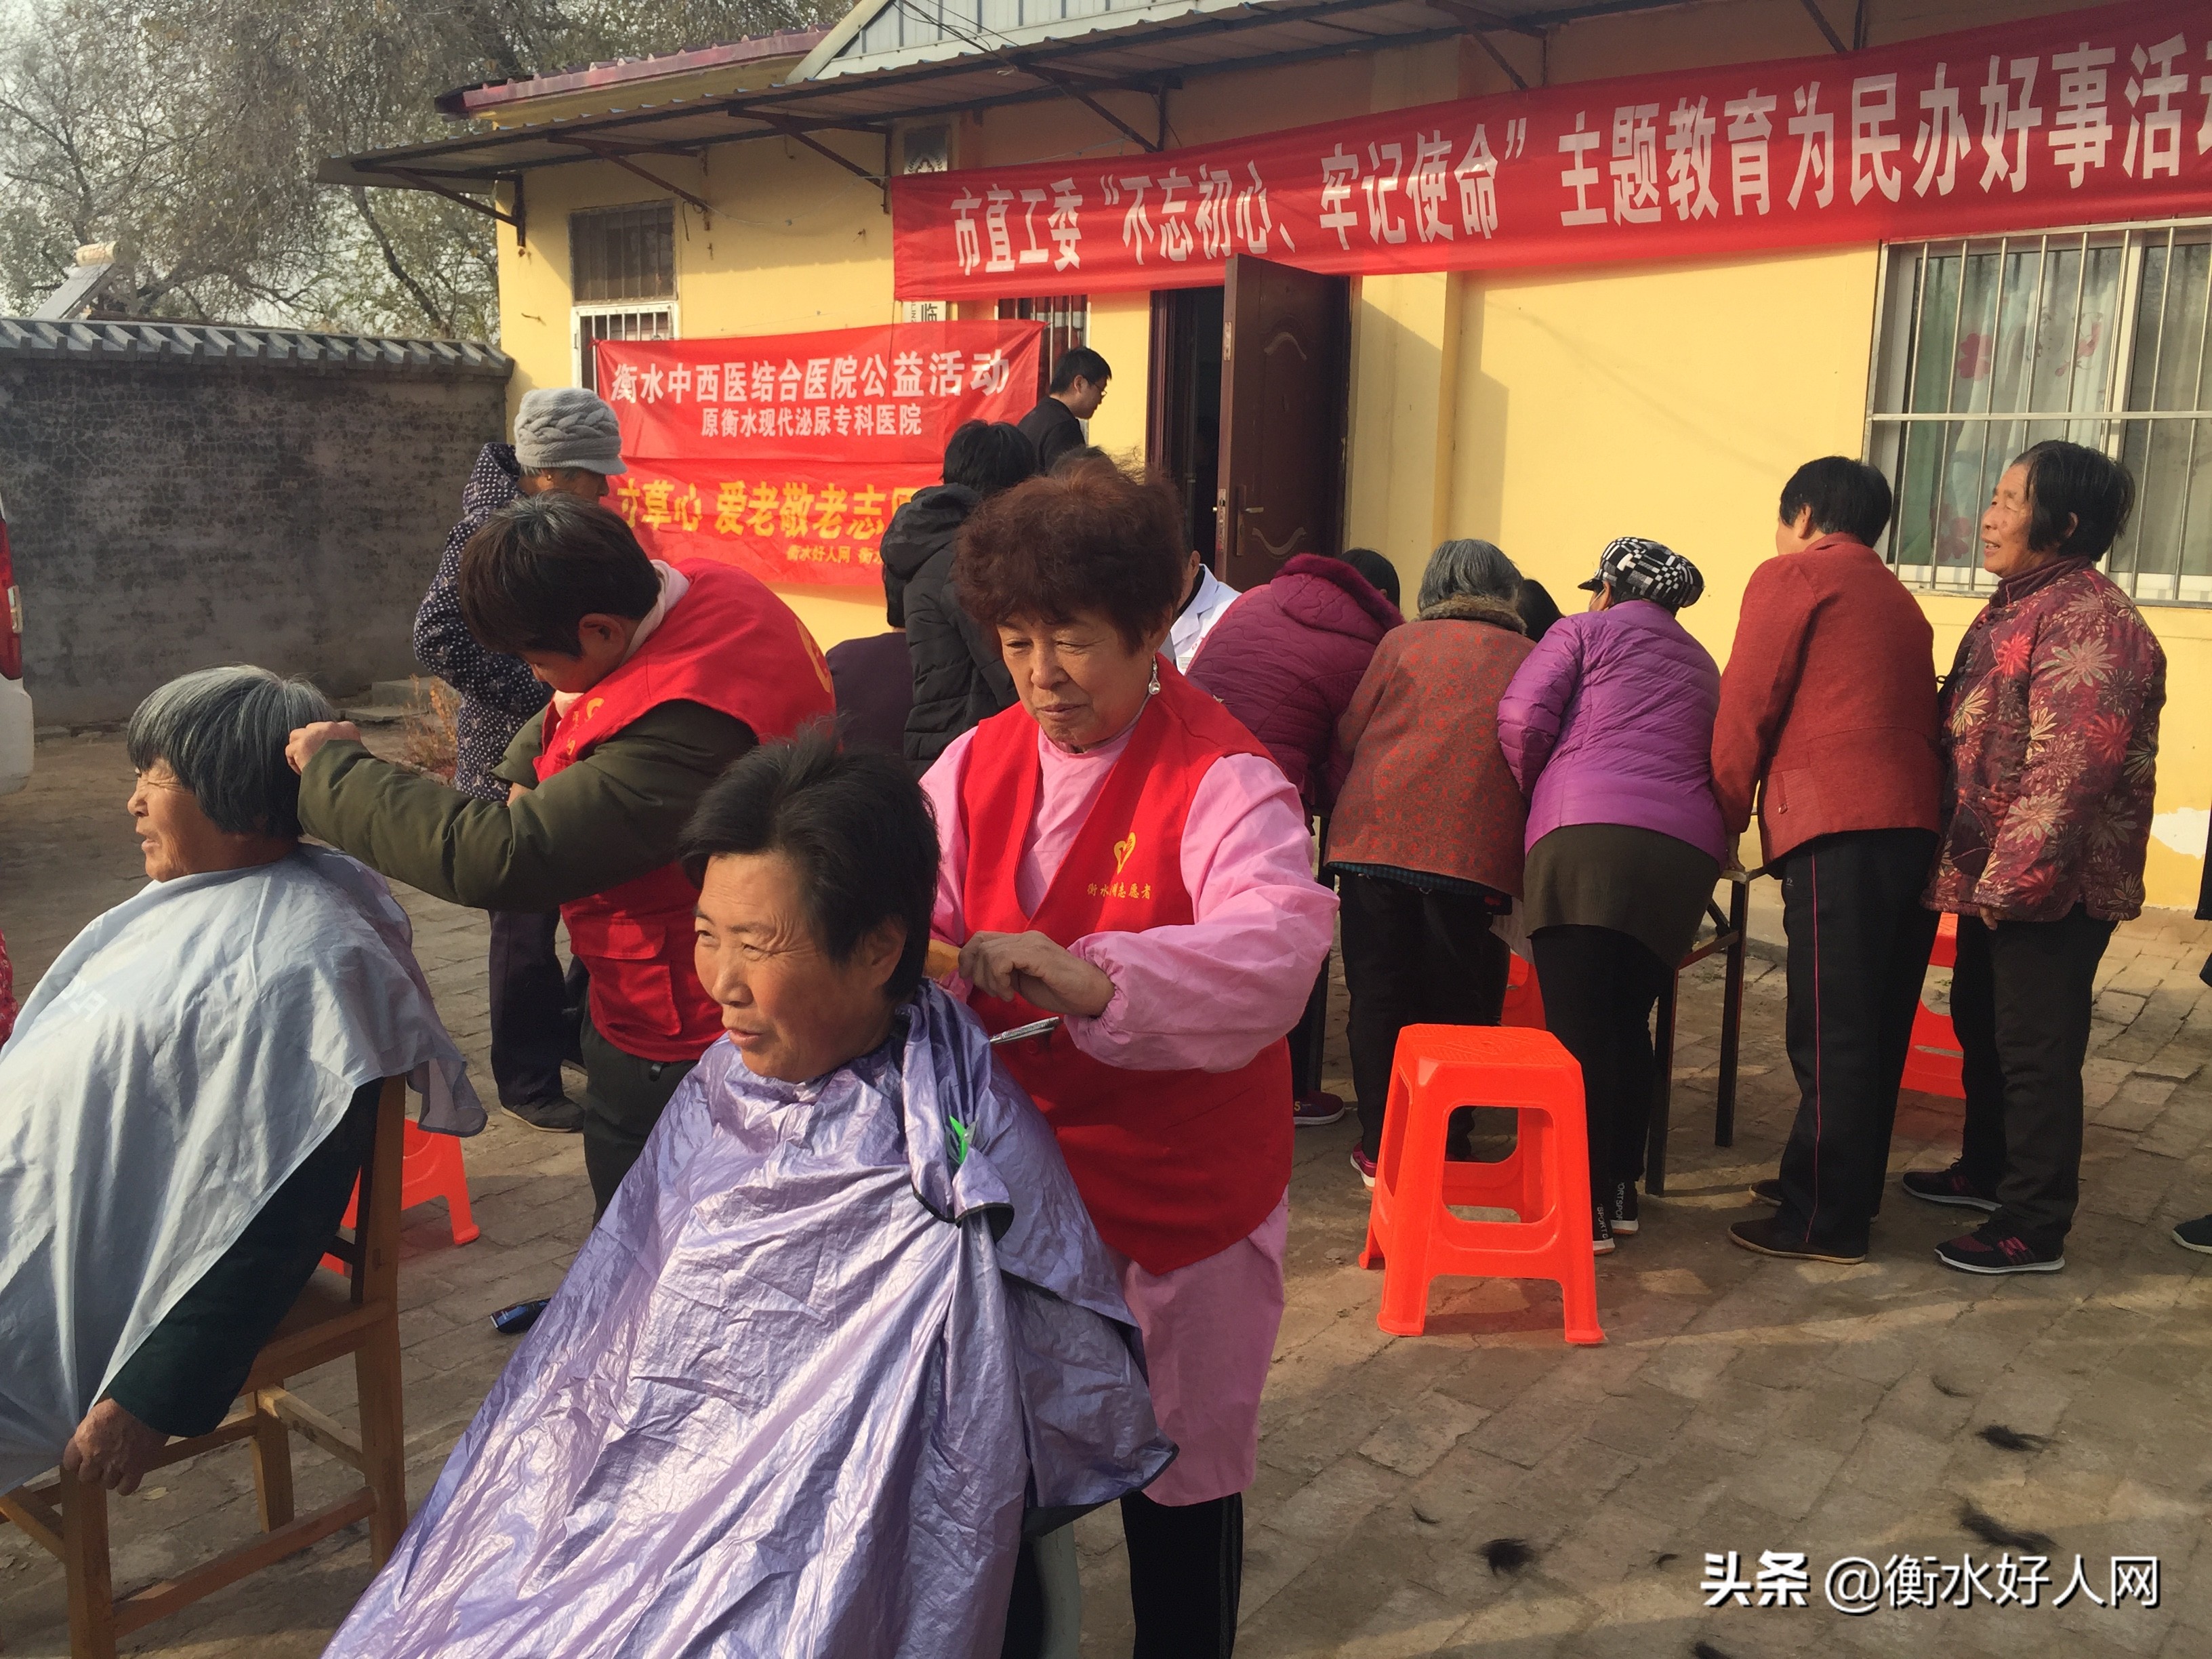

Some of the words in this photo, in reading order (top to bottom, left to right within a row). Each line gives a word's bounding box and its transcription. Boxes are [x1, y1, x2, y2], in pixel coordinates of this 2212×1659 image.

[611, 348, 1010, 404] 衡水中西医结合医院公益活动
[701, 403, 922, 438] 原衡水现代泌尿专科医院
[714, 479, 920, 541] 爱老敬老志
